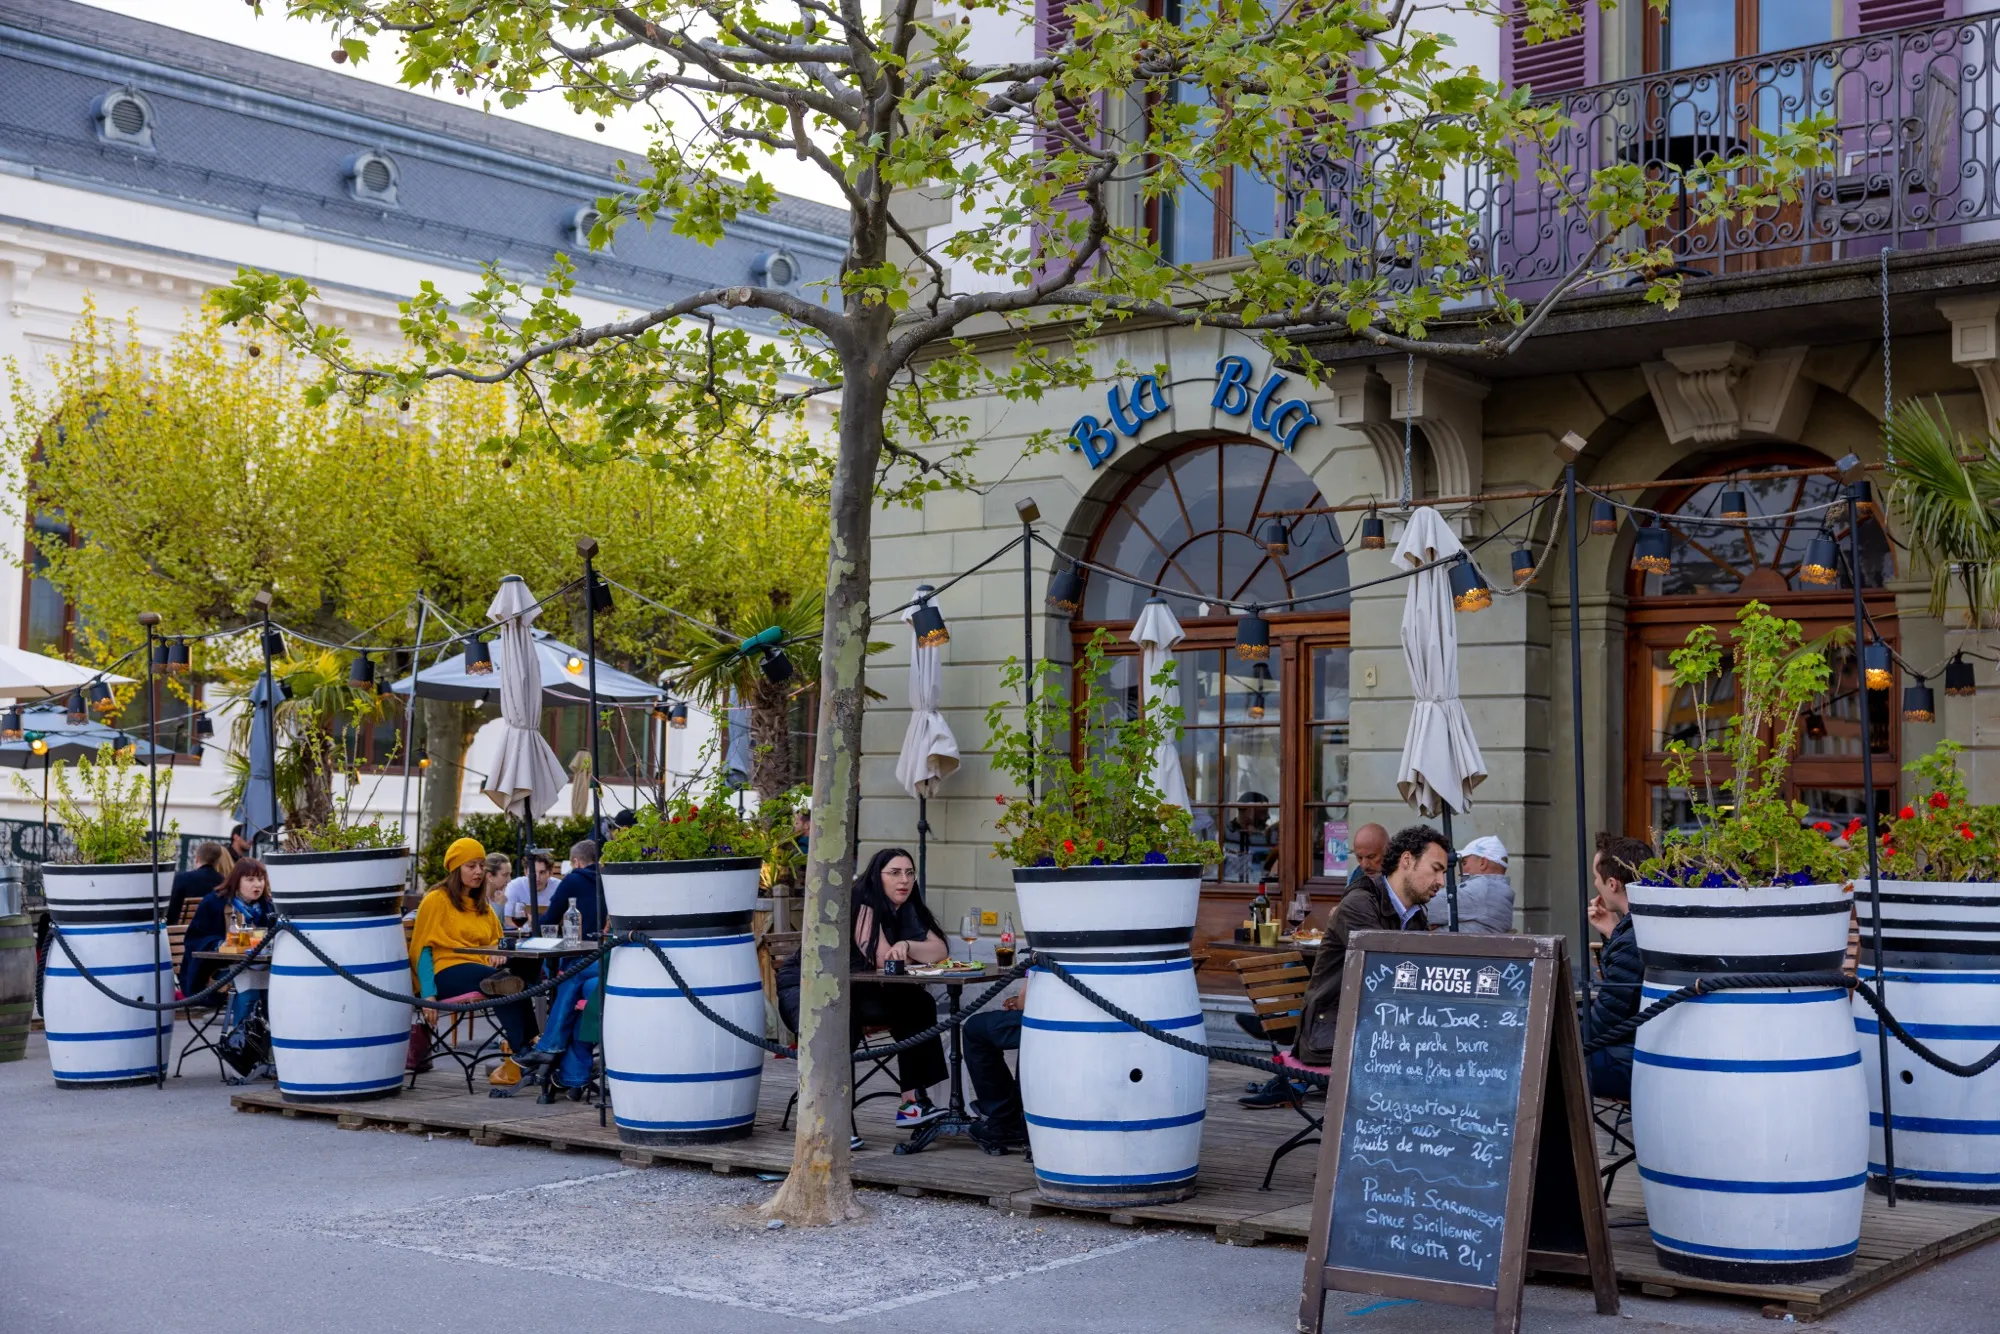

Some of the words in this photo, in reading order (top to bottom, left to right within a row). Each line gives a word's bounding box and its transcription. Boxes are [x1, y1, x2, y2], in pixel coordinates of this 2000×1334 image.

[1067, 374, 1171, 471] Bla
[1210, 355, 1321, 452] Bla
[1365, 963, 1394, 993] BLA
[1425, 966, 1471, 981] VEVEY
[1420, 978, 1472, 994] HOUSE
[1417, 1006, 1439, 1027] du
[1369, 1030, 1395, 1058] filet
[1399, 1033, 1411, 1052] de
[1415, 1031, 1448, 1059] perche
[1455, 1035, 1489, 1053] beurre
[1460, 1102, 1480, 1119] du
[1396, 1135, 1413, 1152] de
[1420, 1143, 1455, 1157] mer
